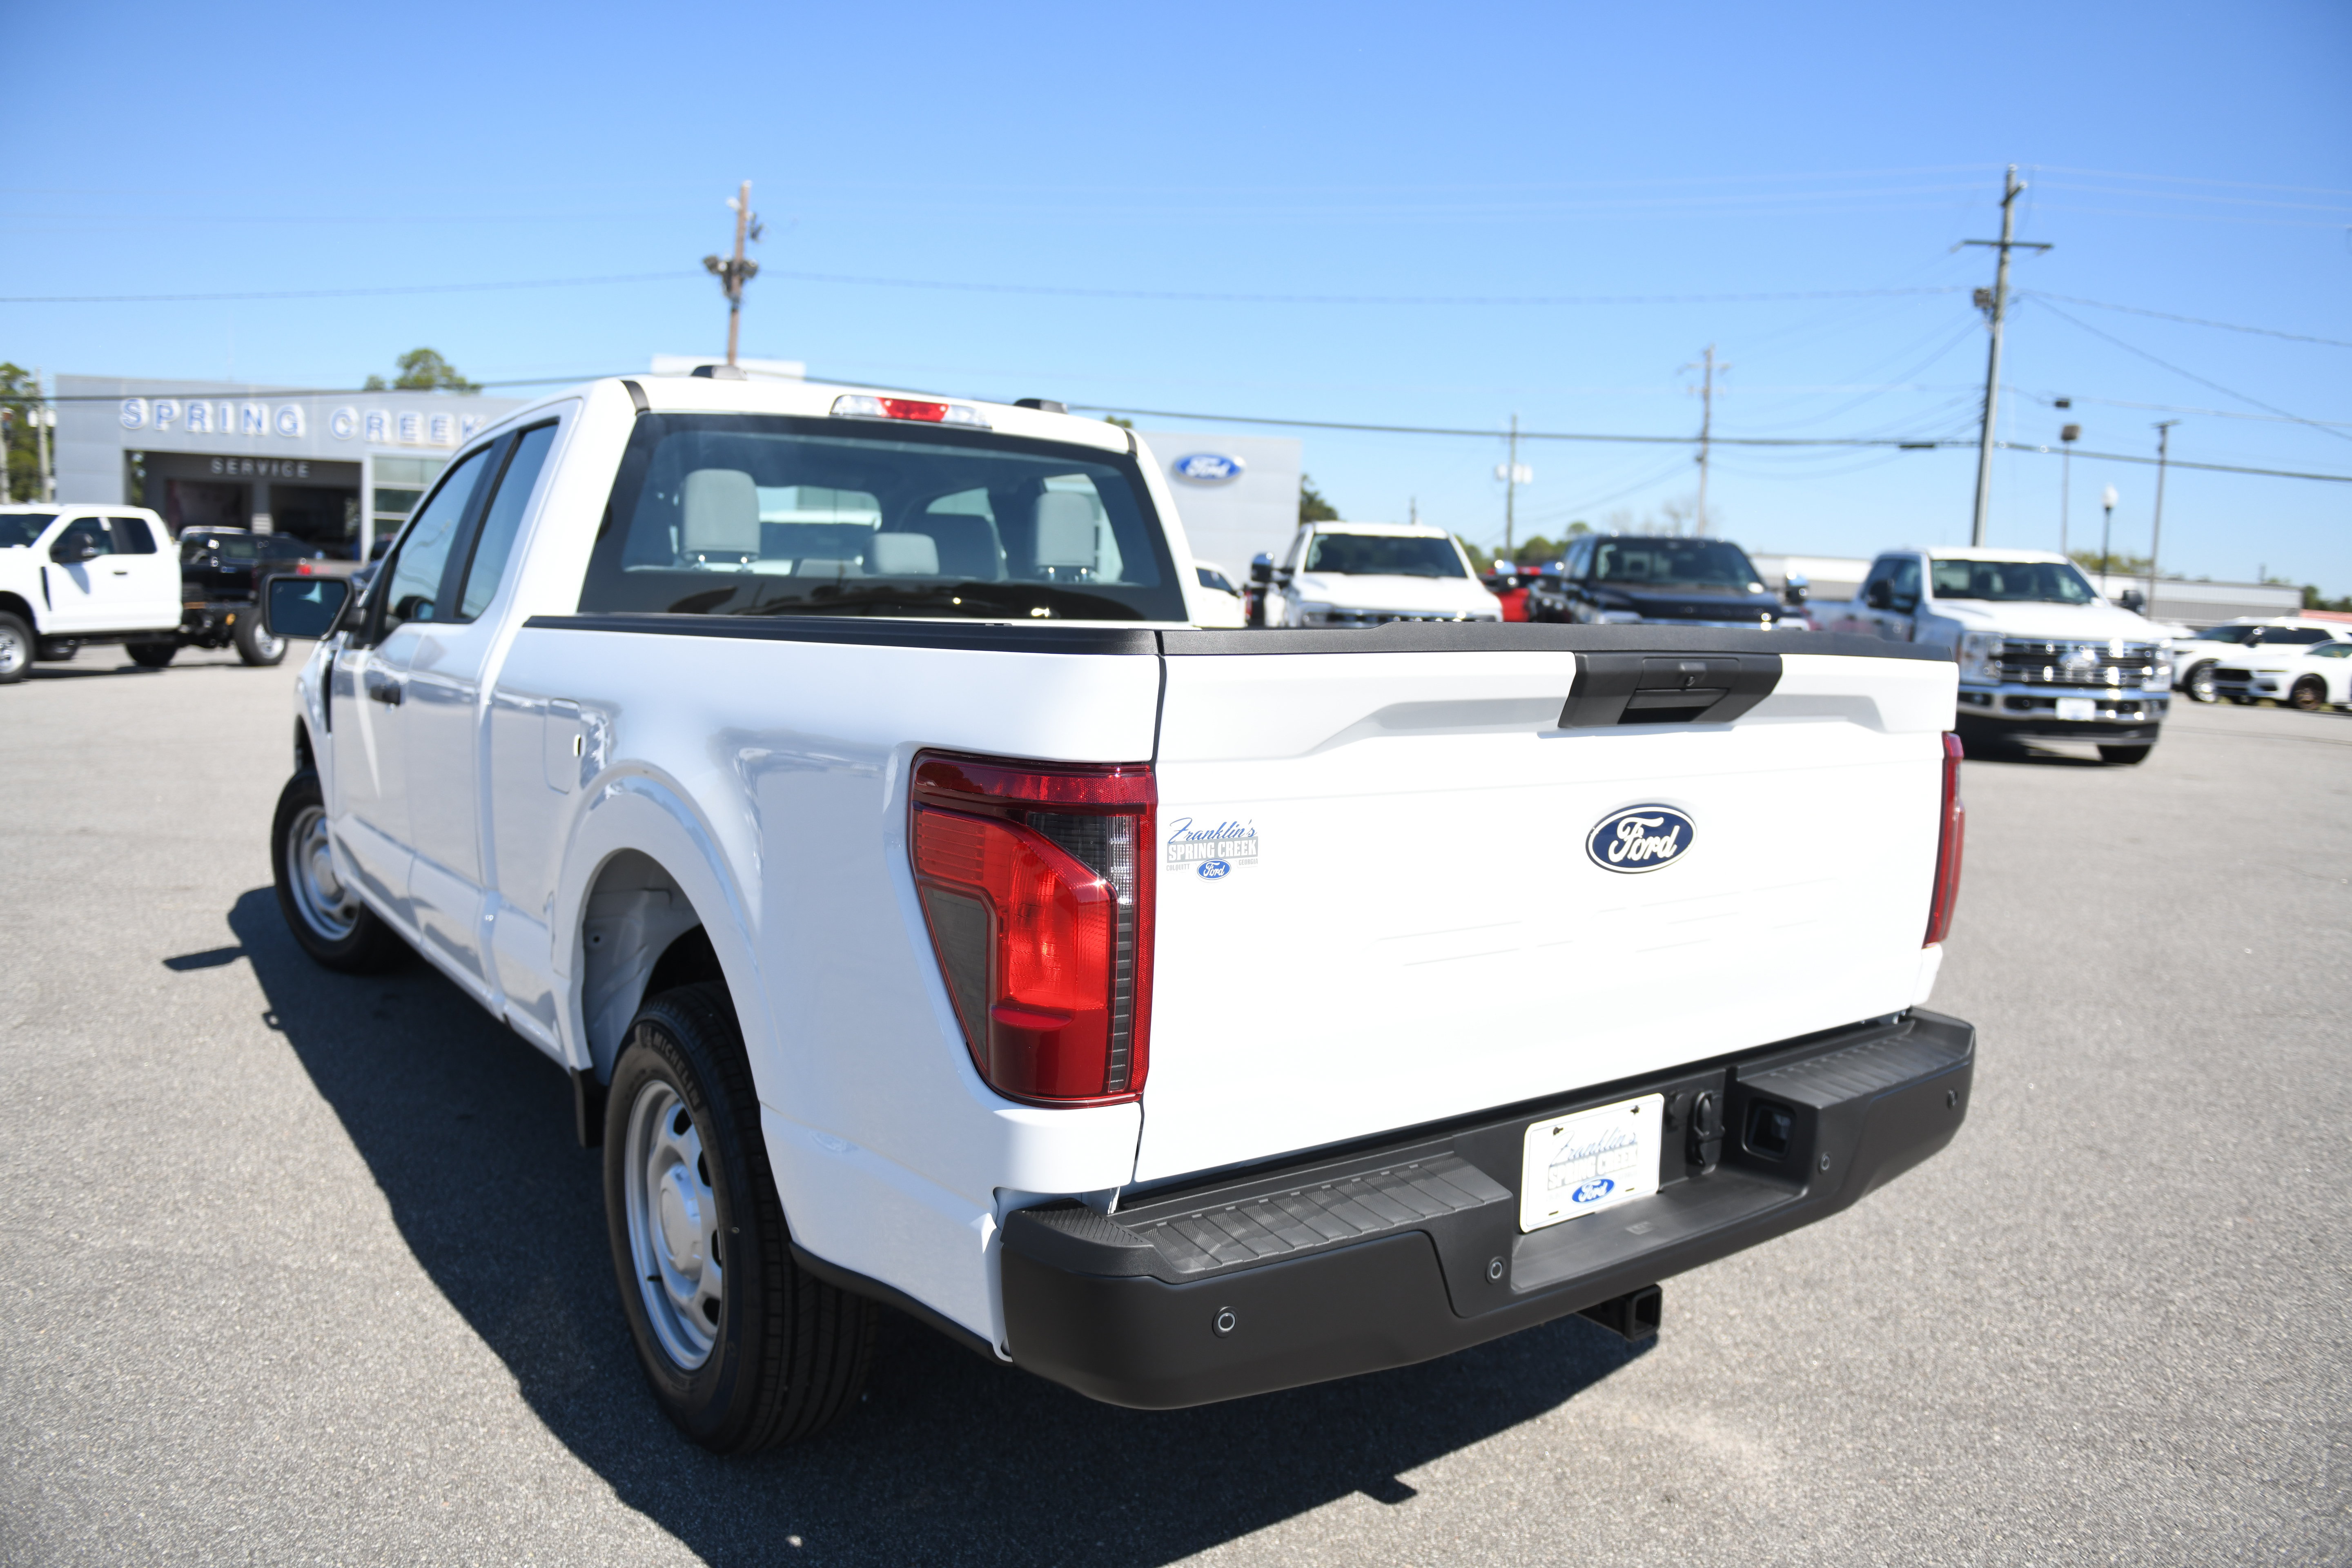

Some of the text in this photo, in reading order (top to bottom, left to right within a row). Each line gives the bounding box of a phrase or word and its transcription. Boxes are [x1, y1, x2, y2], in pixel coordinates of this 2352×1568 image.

[121, 398, 487, 446] SPRING CREEK
[211, 457, 311, 478] SERVICE
[1168, 817, 1257, 844] Franklin's
[1608, 817, 1680, 862] Ford
[1168, 840, 1257, 861] SPRING CREEK
[1203, 862, 1225, 877] Ford
[653, 1032, 700, 1107] MICHELIN
[1579, 1179, 1608, 1202] Ford
